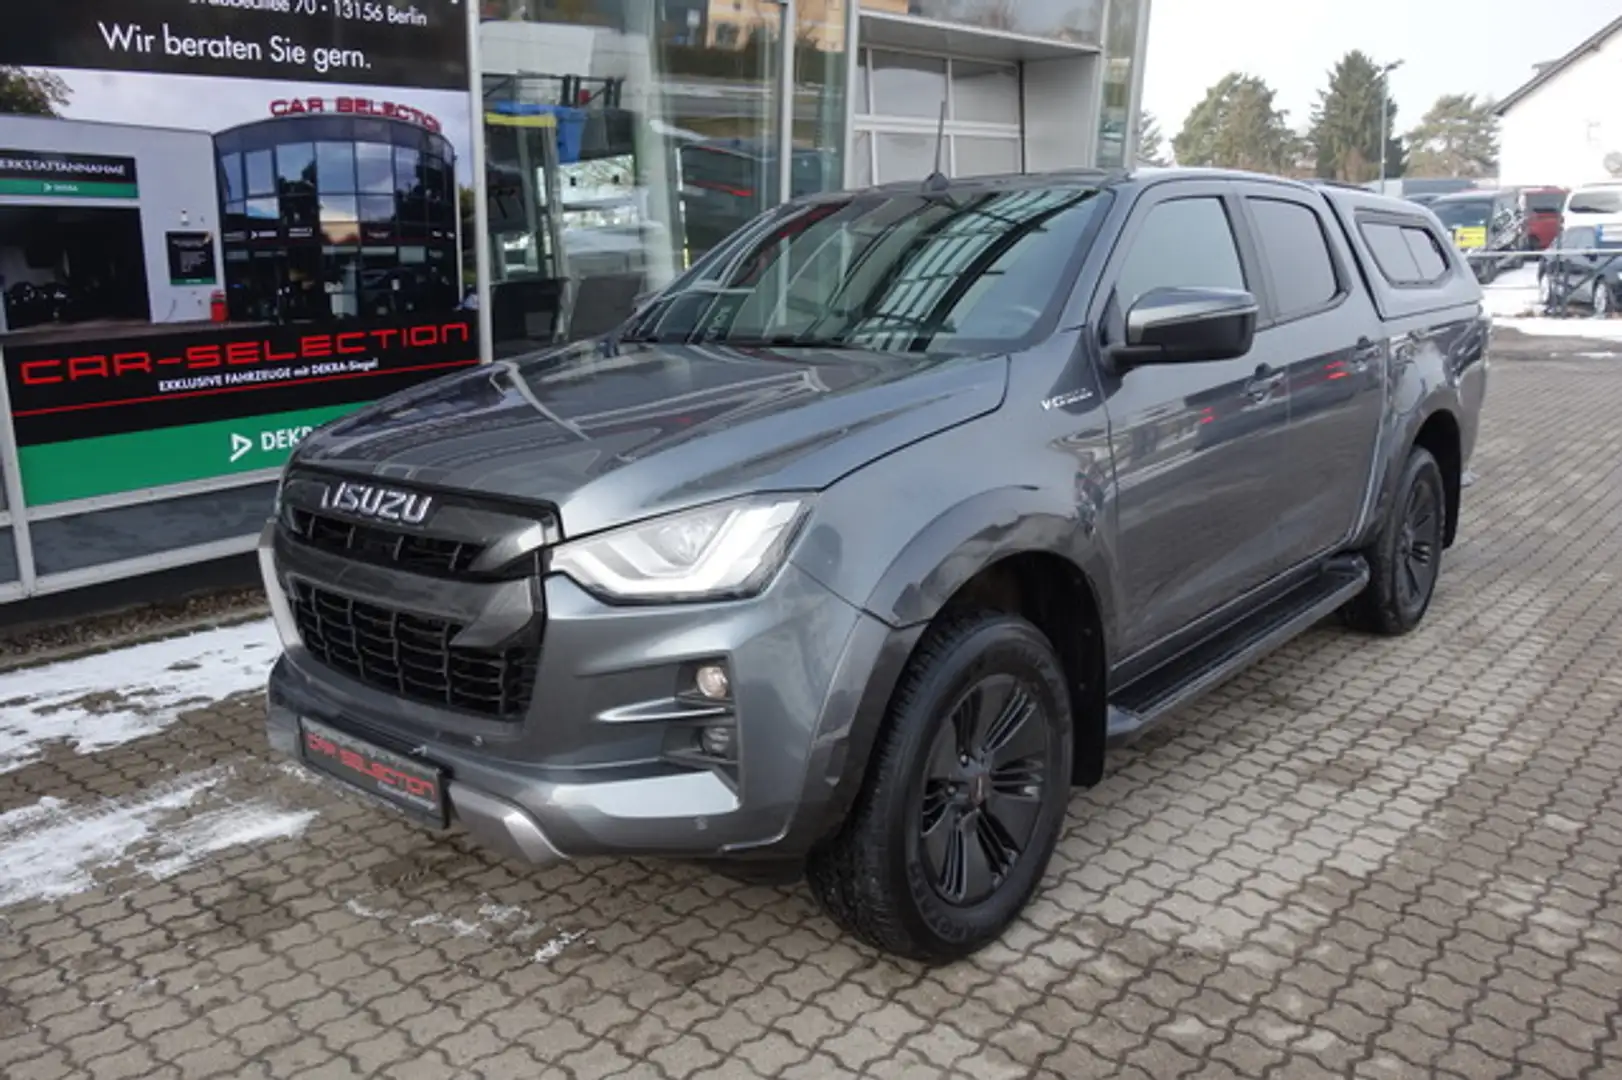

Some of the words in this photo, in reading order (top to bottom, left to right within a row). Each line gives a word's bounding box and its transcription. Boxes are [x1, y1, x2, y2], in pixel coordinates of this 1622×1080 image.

[333, 0, 384, 21] 13156
[387, 5, 427, 26] Berlin
[98, 21, 155, 52] Wir
[163, 23, 262, 60] beraten
[269, 35, 306, 64] Sie
[313, 47, 372, 73] gern.
[269, 97, 324, 116] CAR
[19, 322, 469, 385] CAR-SELECTION
[158, 374, 223, 392] EXKLUSIVE
[225, 368, 291, 385] FAHRZEUGE
[293, 366, 309, 377] mit
[331, 481, 433, 523] ISUZU
